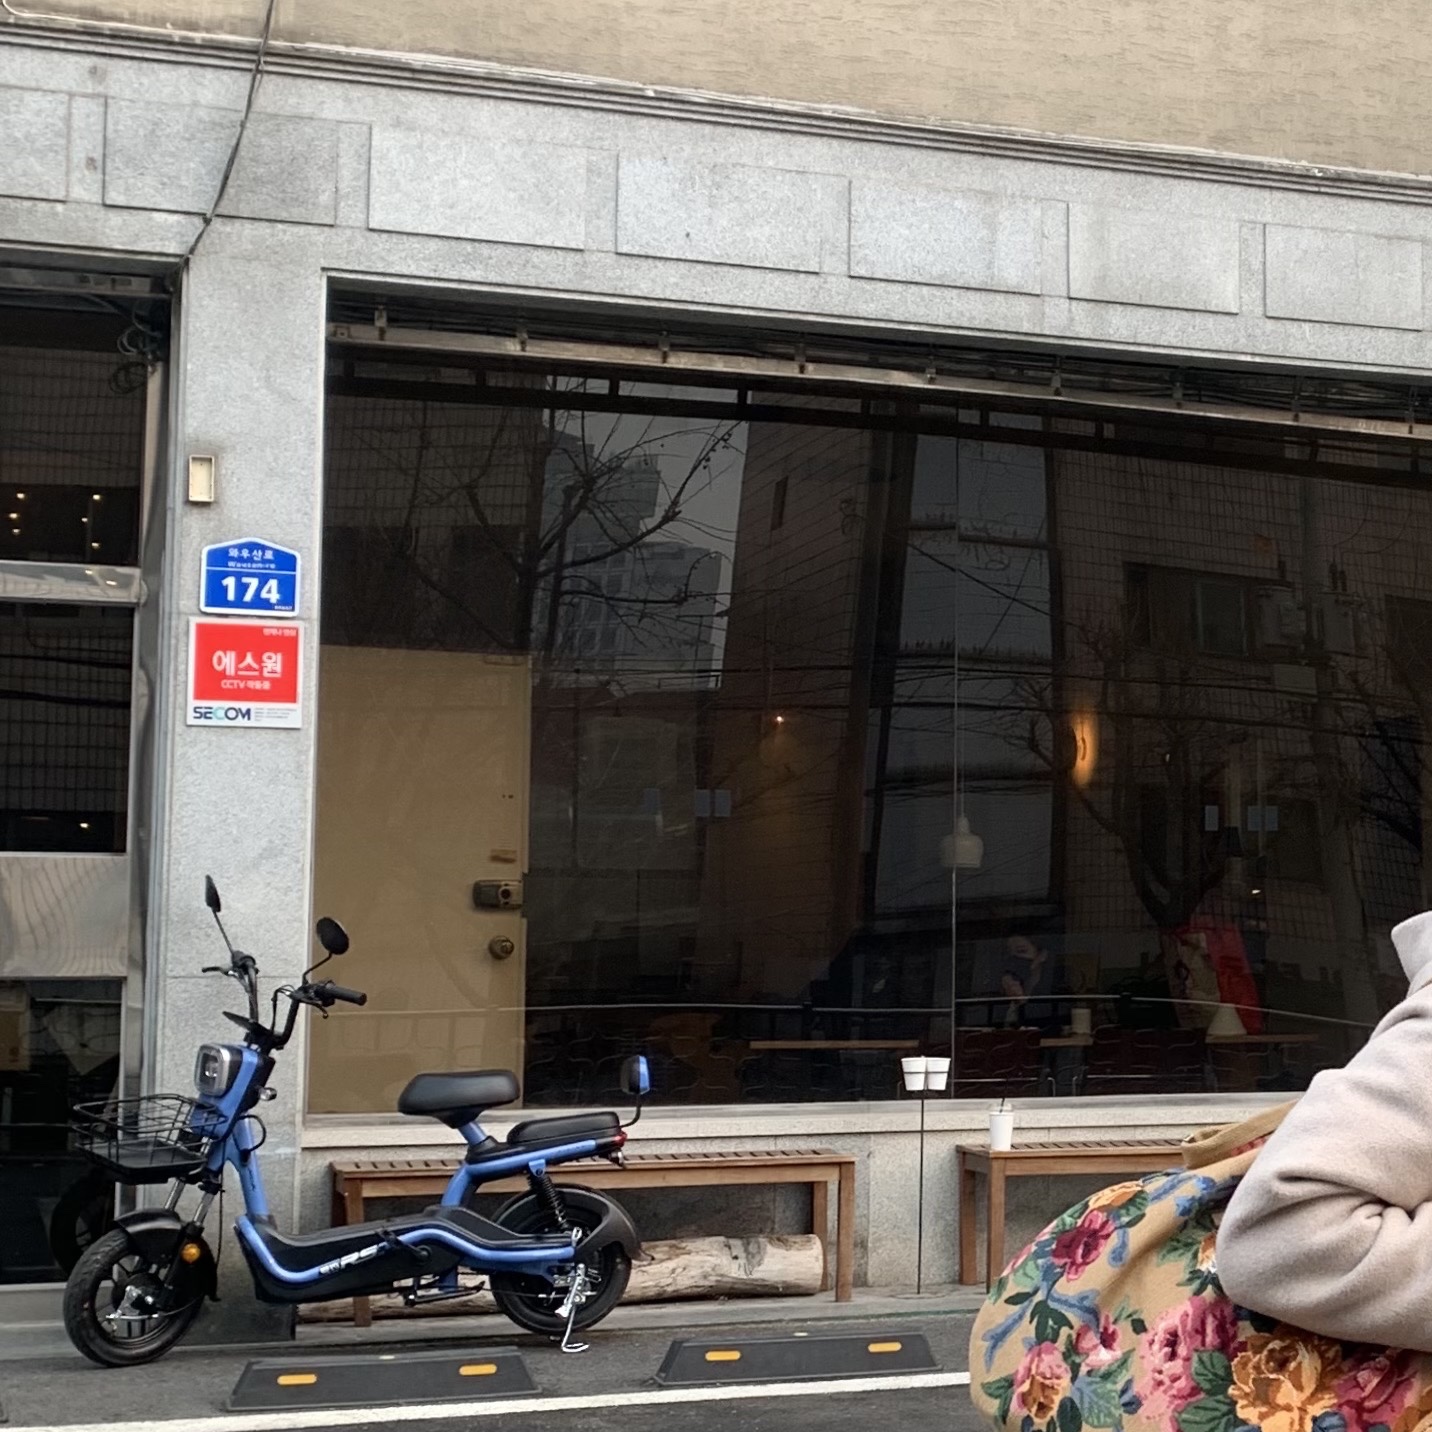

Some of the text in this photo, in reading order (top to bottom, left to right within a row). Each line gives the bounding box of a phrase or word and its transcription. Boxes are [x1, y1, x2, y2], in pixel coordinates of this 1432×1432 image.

[228, 548, 274, 561] 와우산로
[221, 576, 280, 604] 174
[212, 650, 282, 678] 에스원
[221, 679, 245, 689] CCTV
[193, 706, 251, 721] SECOM
